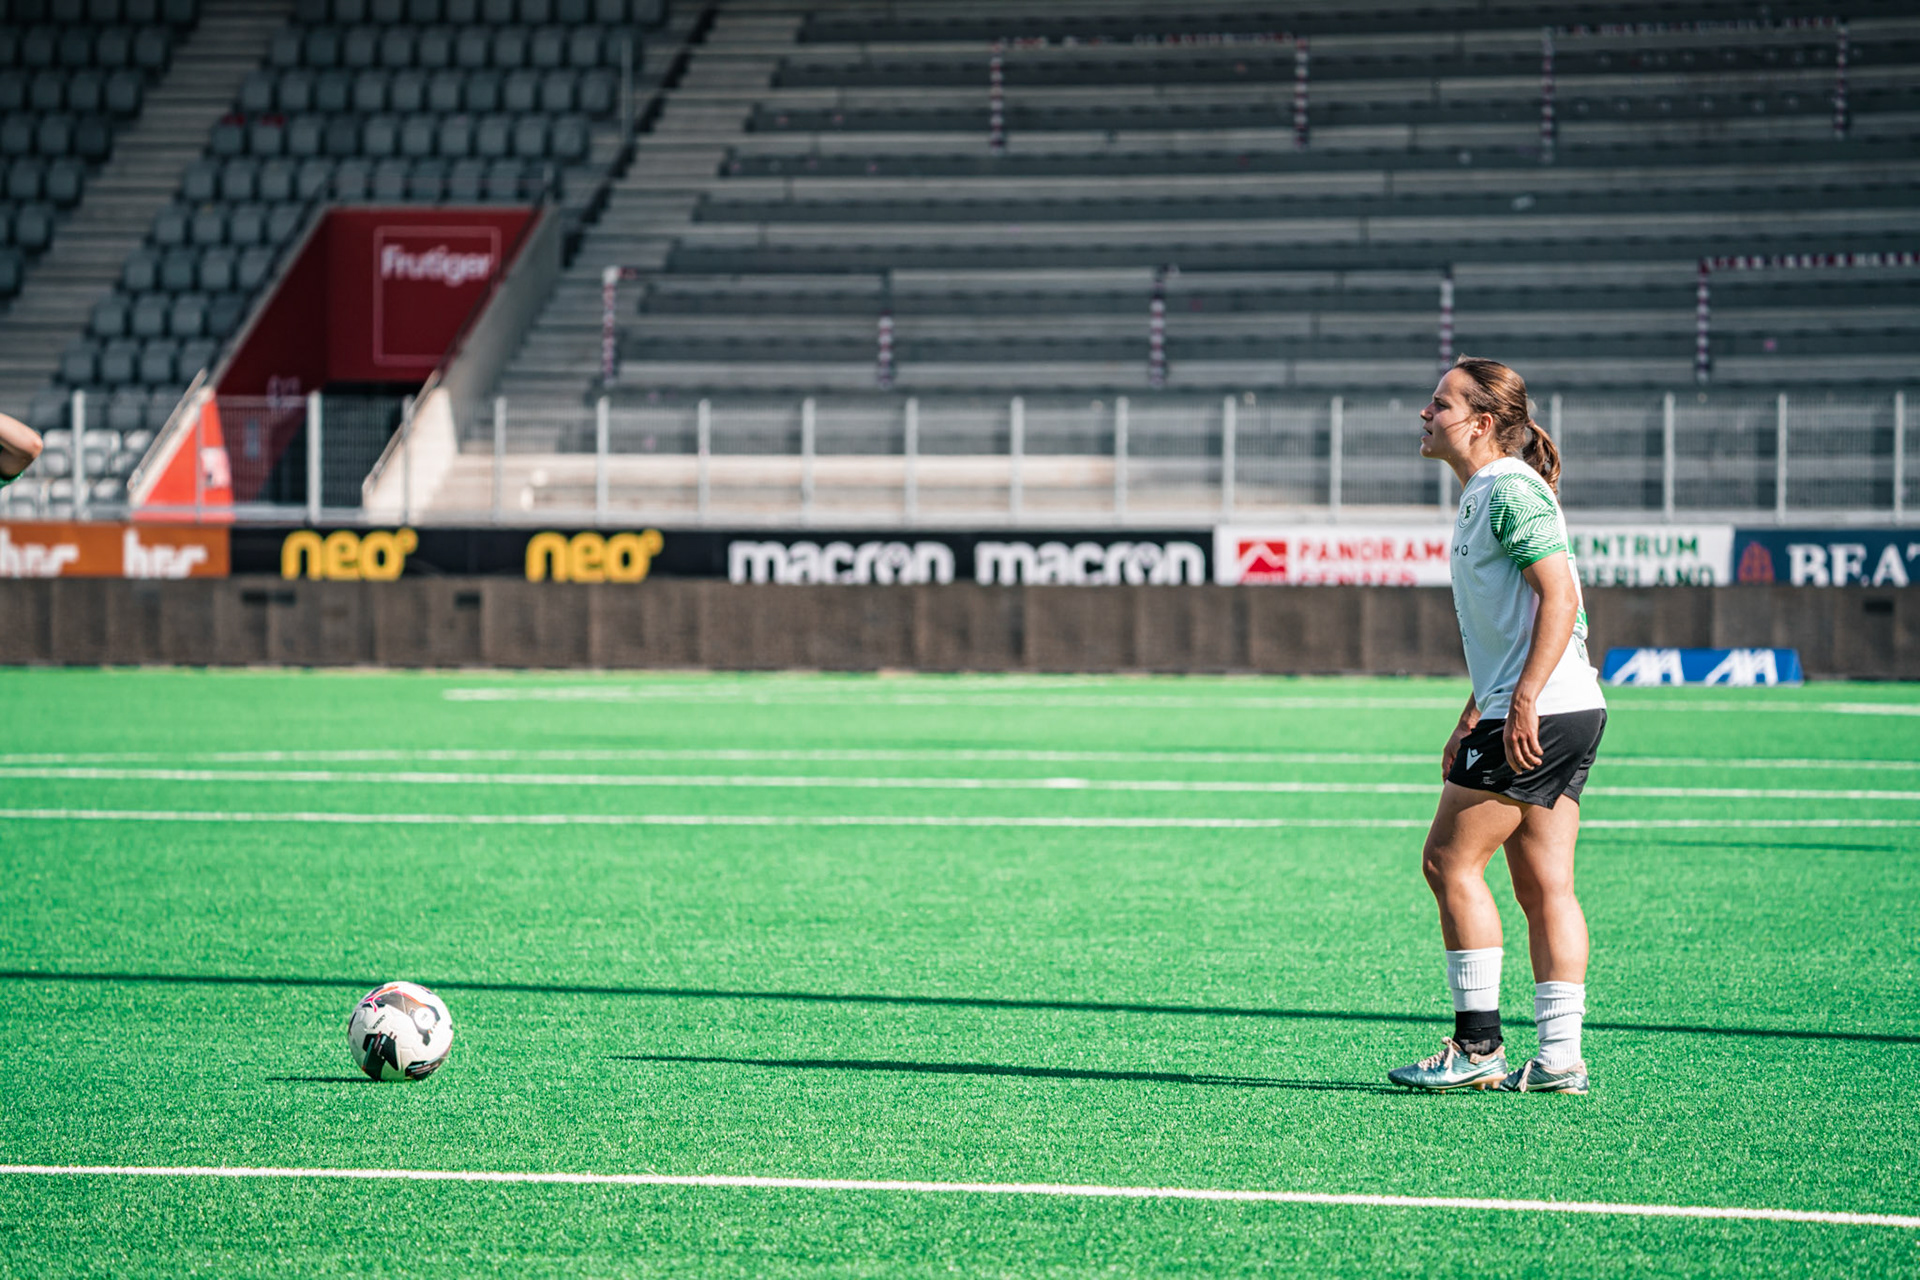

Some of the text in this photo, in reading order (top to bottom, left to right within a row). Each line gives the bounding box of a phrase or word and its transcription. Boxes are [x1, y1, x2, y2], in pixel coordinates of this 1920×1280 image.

[381, 244, 490, 287] Frutiger
[123, 528, 207, 579] hrs
[728, 540, 955, 586] macron
[975, 541, 1206, 587] macron
[1299, 537, 1451, 561] PANORAM
[1573, 533, 1698, 559] ENTRUM
